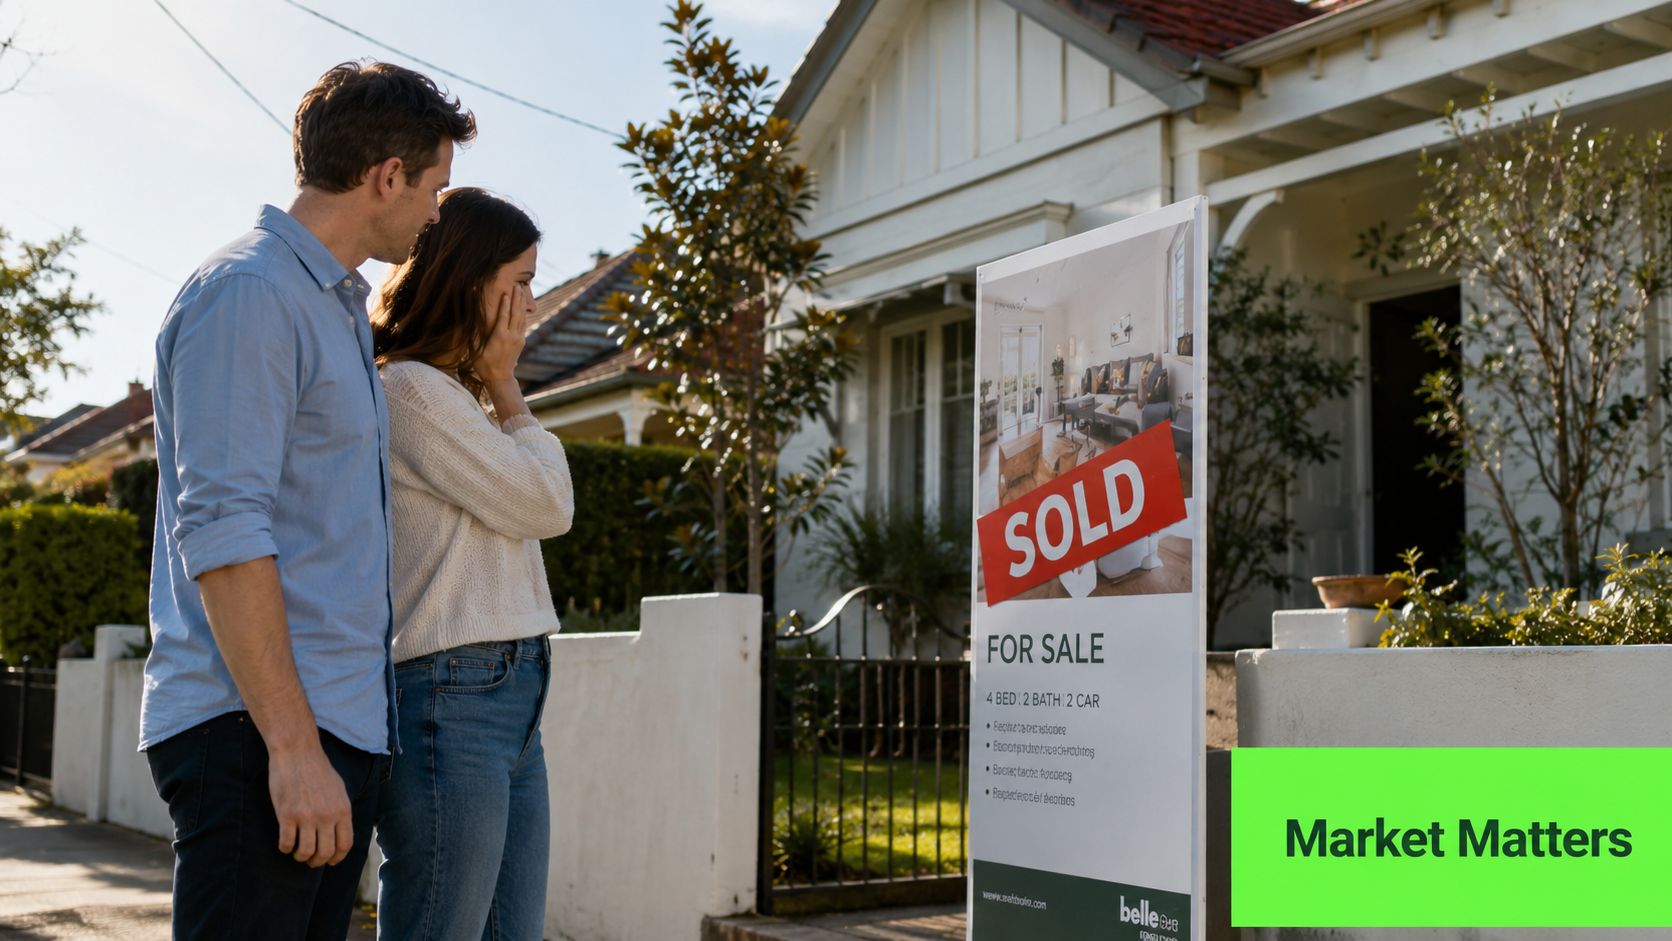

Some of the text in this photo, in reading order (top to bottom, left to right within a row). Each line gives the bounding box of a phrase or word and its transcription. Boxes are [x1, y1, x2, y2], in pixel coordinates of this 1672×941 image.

[1005, 459, 1145, 578] SOLD
[987, 632, 1105, 664] FOR SALE
[986, 691, 1100, 708] 4 BED 2 BATH 2 CAR
[1120, 895, 1159, 929] belle
